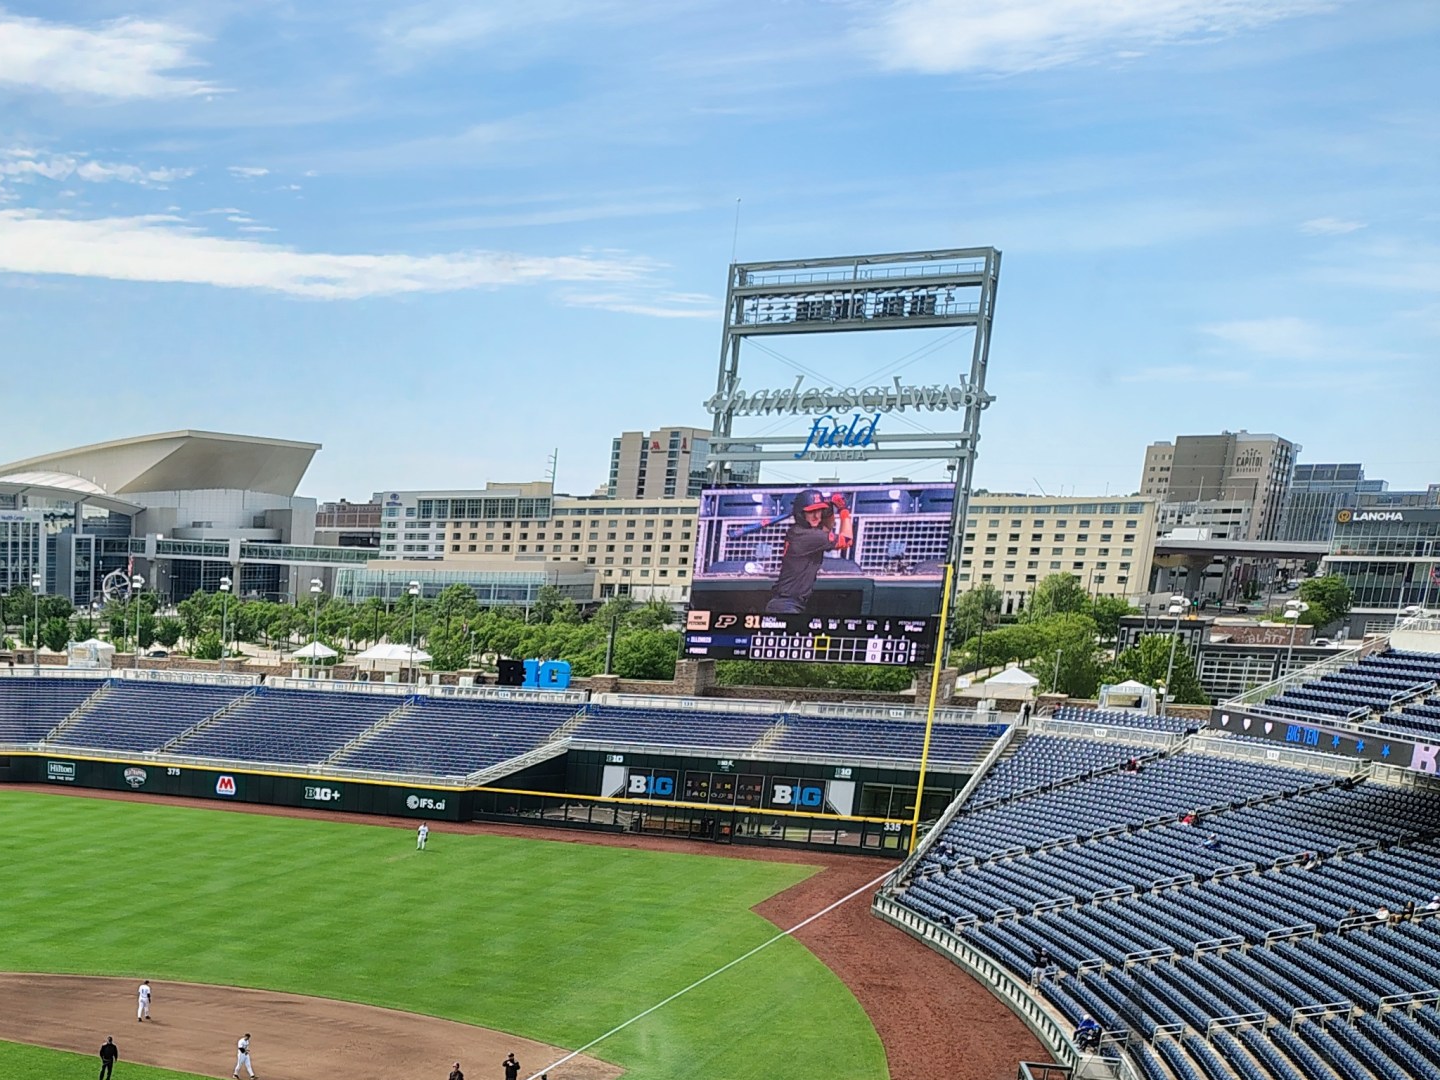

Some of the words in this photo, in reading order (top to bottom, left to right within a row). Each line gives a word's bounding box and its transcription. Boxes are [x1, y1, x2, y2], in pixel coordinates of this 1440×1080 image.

[794, 413, 881, 459] field
[809, 451, 867, 461] OMAHA
[1236, 457, 1263, 467] CAPITOL
[1352, 511, 1403, 521] LANOHA
[714, 615, 737, 628] P
[744, 615, 760, 628] 31
[1248, 632, 1285, 644] BLATT
[756, 638, 761, 646] 0
[886, 642, 892, 650] 4
[899, 642, 905, 650] 0
[898, 654, 904, 662] 0
[1285, 725, 1302, 742] BIG
[1302, 728, 1320, 746] TEN
[50, 763, 73, 774] Hilton
[167, 767, 181, 776] 375
[218, 778, 233, 789] M
[419, 798, 445, 810] IFS.ai
[883, 822, 901, 831] 335
